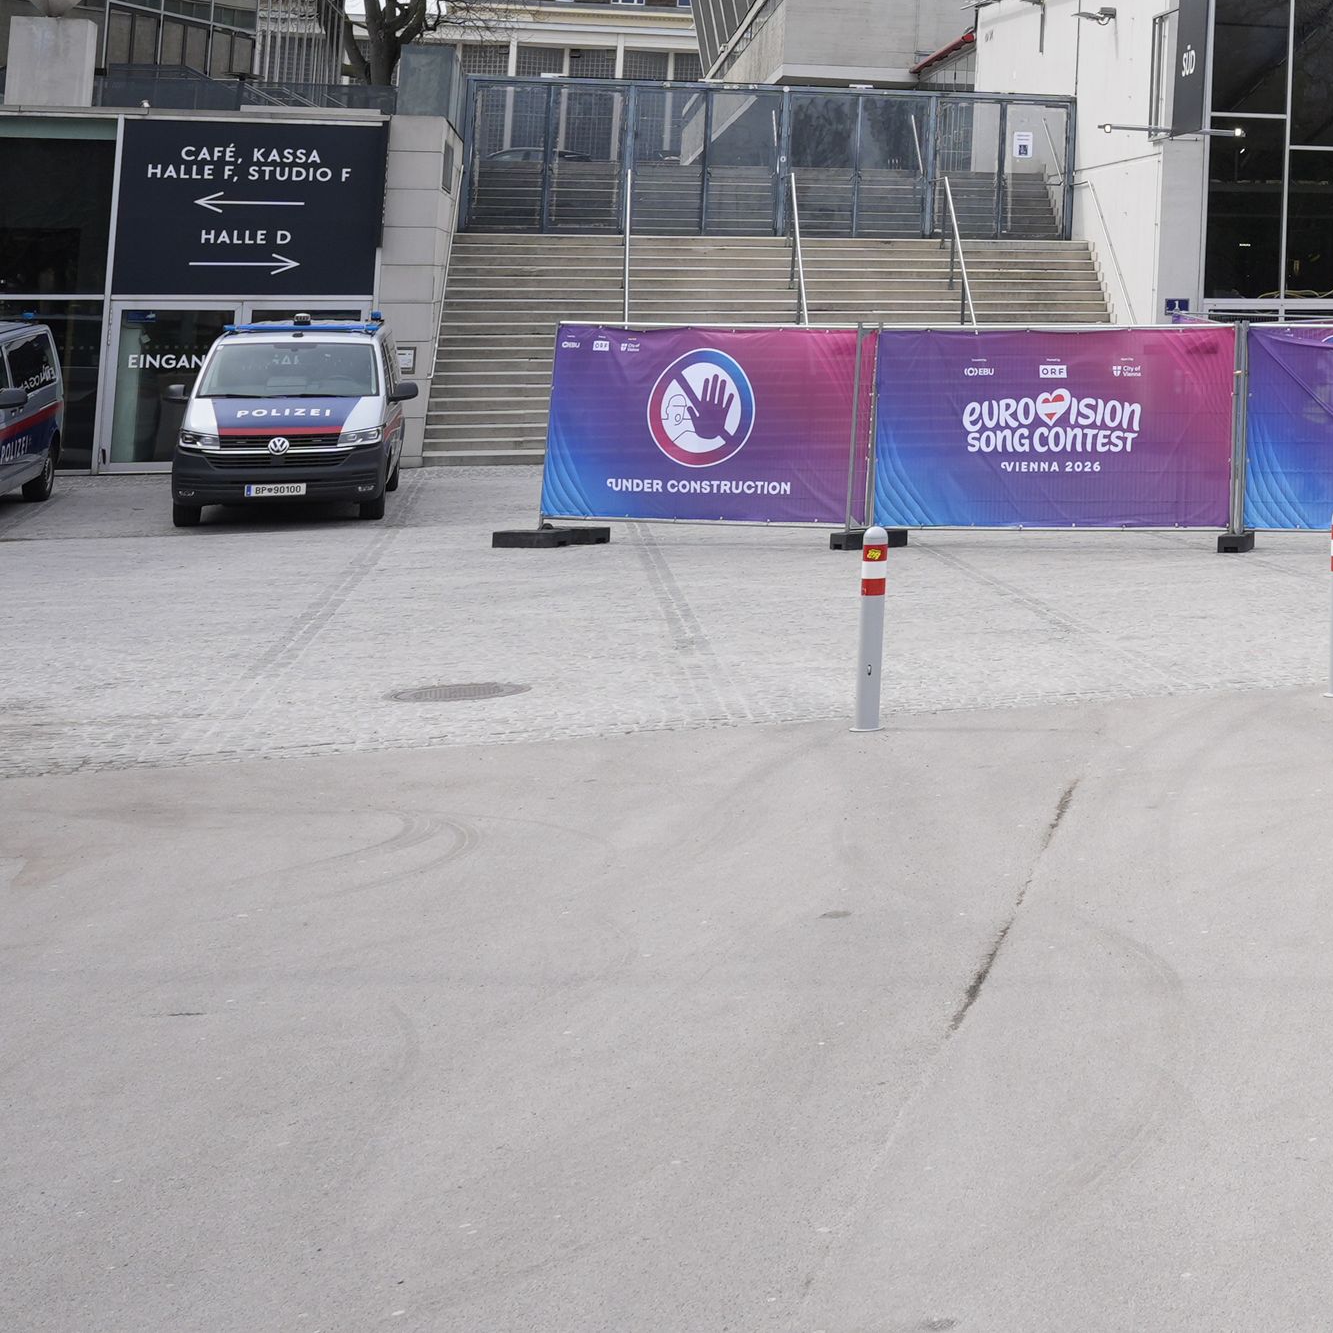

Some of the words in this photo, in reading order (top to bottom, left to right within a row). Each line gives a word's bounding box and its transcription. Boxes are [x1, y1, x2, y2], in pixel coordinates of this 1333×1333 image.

[1182, 44, 1196, 77] SÜD
[181, 143, 243, 164] CAFÉ,
[252, 148, 321, 163] KASSA
[147, 164, 214, 179] HALLE
[224, 166, 239, 182] F,
[248, 166, 332, 182] STUDIO
[341, 168, 352, 182] F
[201, 229, 267, 244] HALLE
[276, 230, 291, 244] D
[1041, 367, 1065, 376] ORF
[1123, 366, 1133, 374] City
[236, 408, 331, 418] POLIZEI
[967, 428, 1030, 452] SONG
[1033, 426, 1138, 452] CONTEST
[1, 435, 28, 464] POLIZEI
[1001, 461, 1060, 472] VIENNA
[1065, 461, 1101, 472] 2026
[255, 485, 267, 495] BP
[273, 484, 301, 495] 90100
[606, 478, 662, 493] UNDER
[667, 479, 791, 495] CONSTRUCTION
